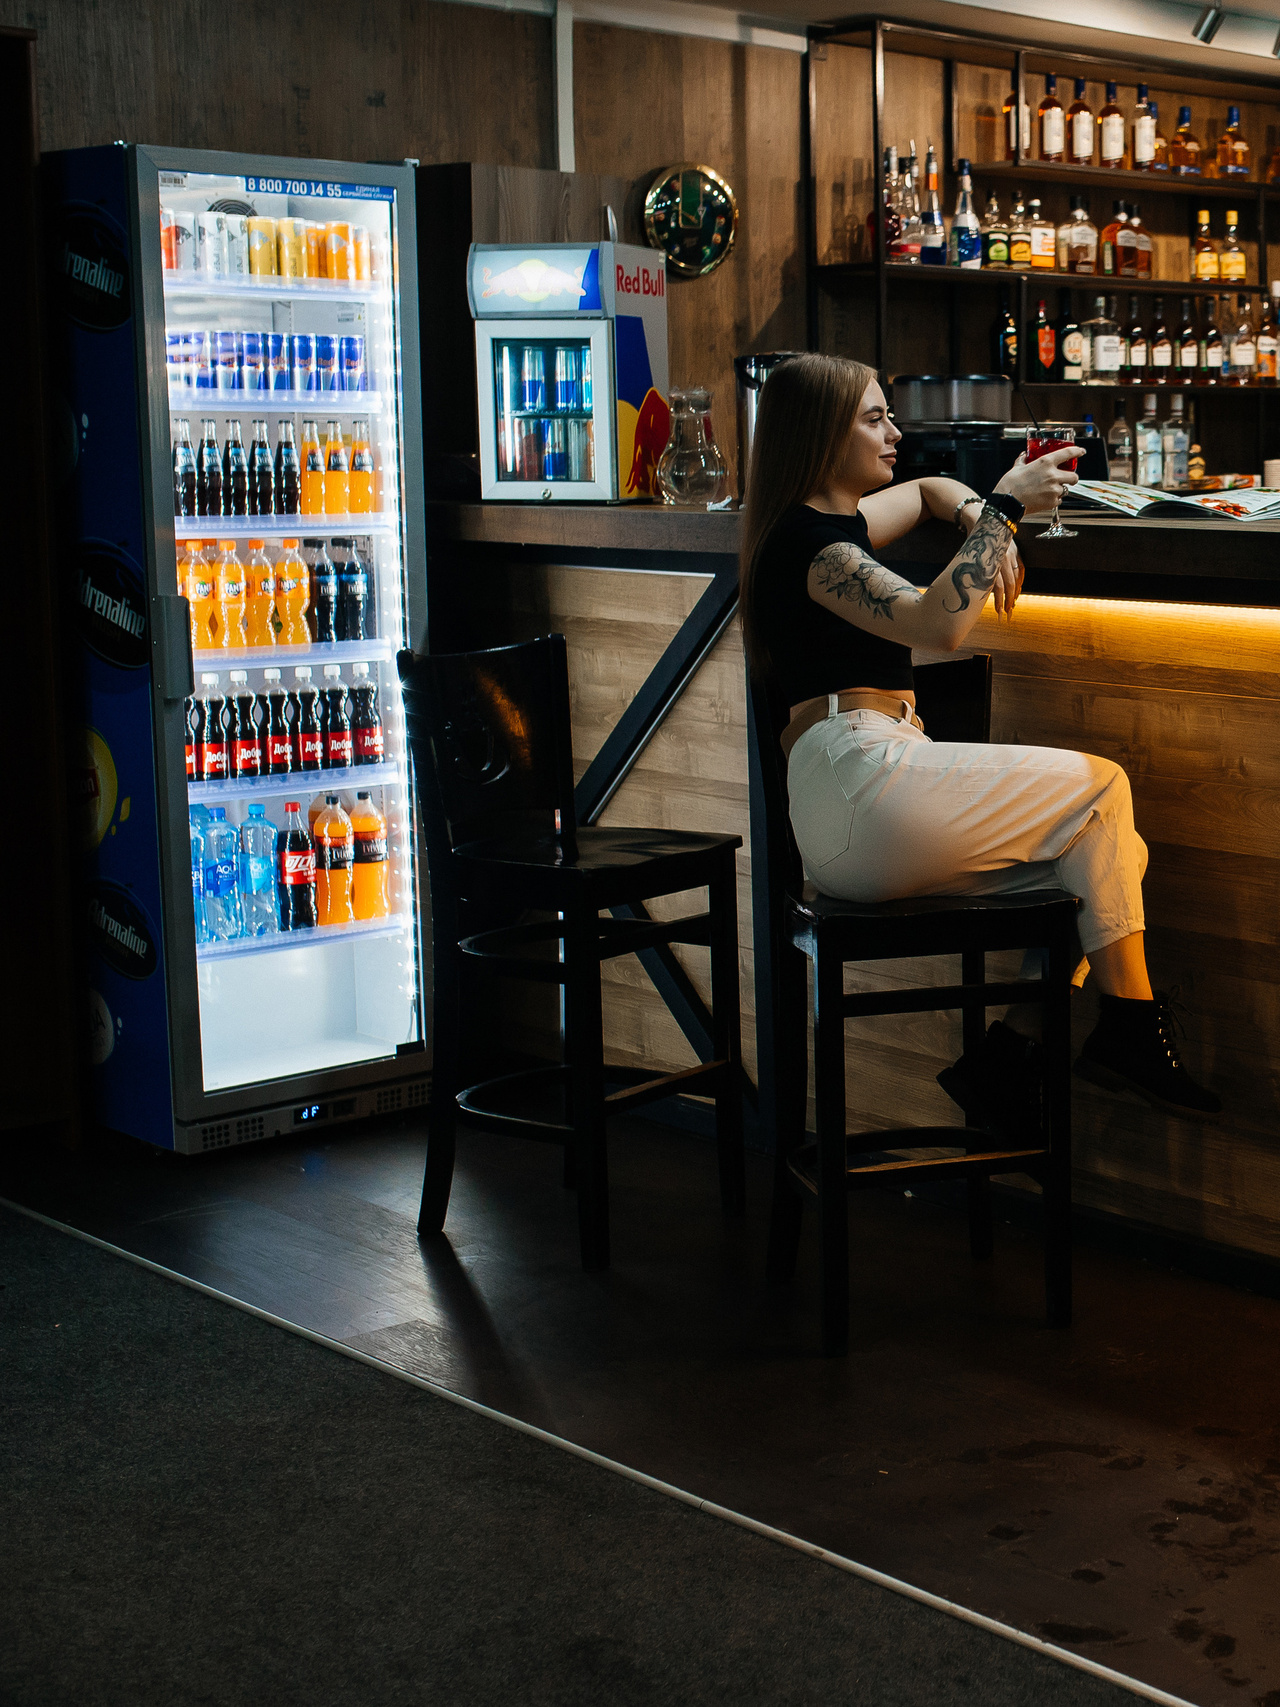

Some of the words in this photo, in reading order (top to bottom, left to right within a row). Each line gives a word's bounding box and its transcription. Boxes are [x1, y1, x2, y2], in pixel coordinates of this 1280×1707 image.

[248, 177, 255, 190] 8
[259, 179, 282, 192] 800
[286, 181, 308, 194] 700
[310, 182, 324, 196] 14
[327, 184, 342, 197] 55
[355, 185, 380, 193] ЕДИНАЯ
[61, 241, 124, 299] drenaline
[616, 264, 641, 294] Red
[642, 267, 664, 297] Bull
[88, 898, 148, 959] Adrenaline
